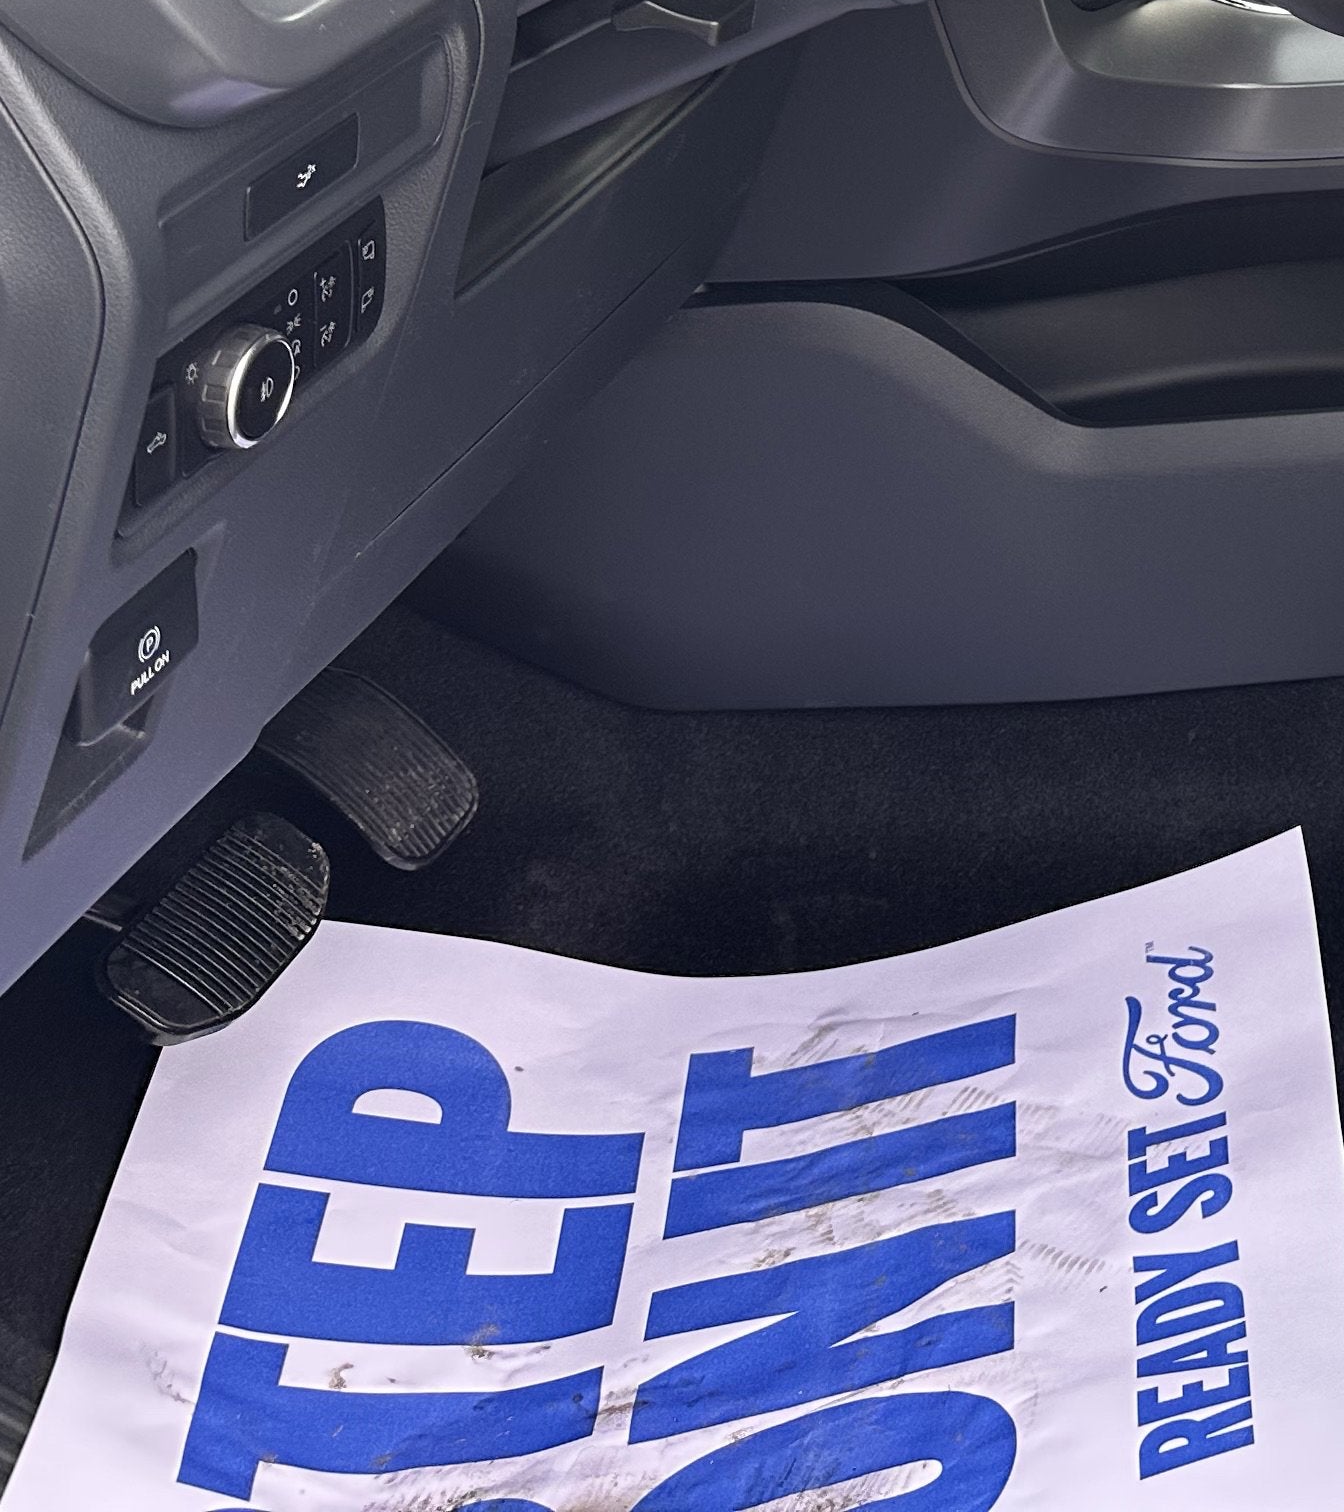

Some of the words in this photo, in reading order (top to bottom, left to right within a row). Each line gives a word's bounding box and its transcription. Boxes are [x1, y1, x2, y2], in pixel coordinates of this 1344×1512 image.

[130, 666, 155, 696] PULL
[154, 649, 170, 672] ON
[1122, 945, 1224, 1107] Ford
[663, 1013, 1017, 1240] IT
[1127, 1111, 1233, 1234] SET
[176, 1020, 645, 1512] TEP
[1132, 1239, 1255, 1481] READY
